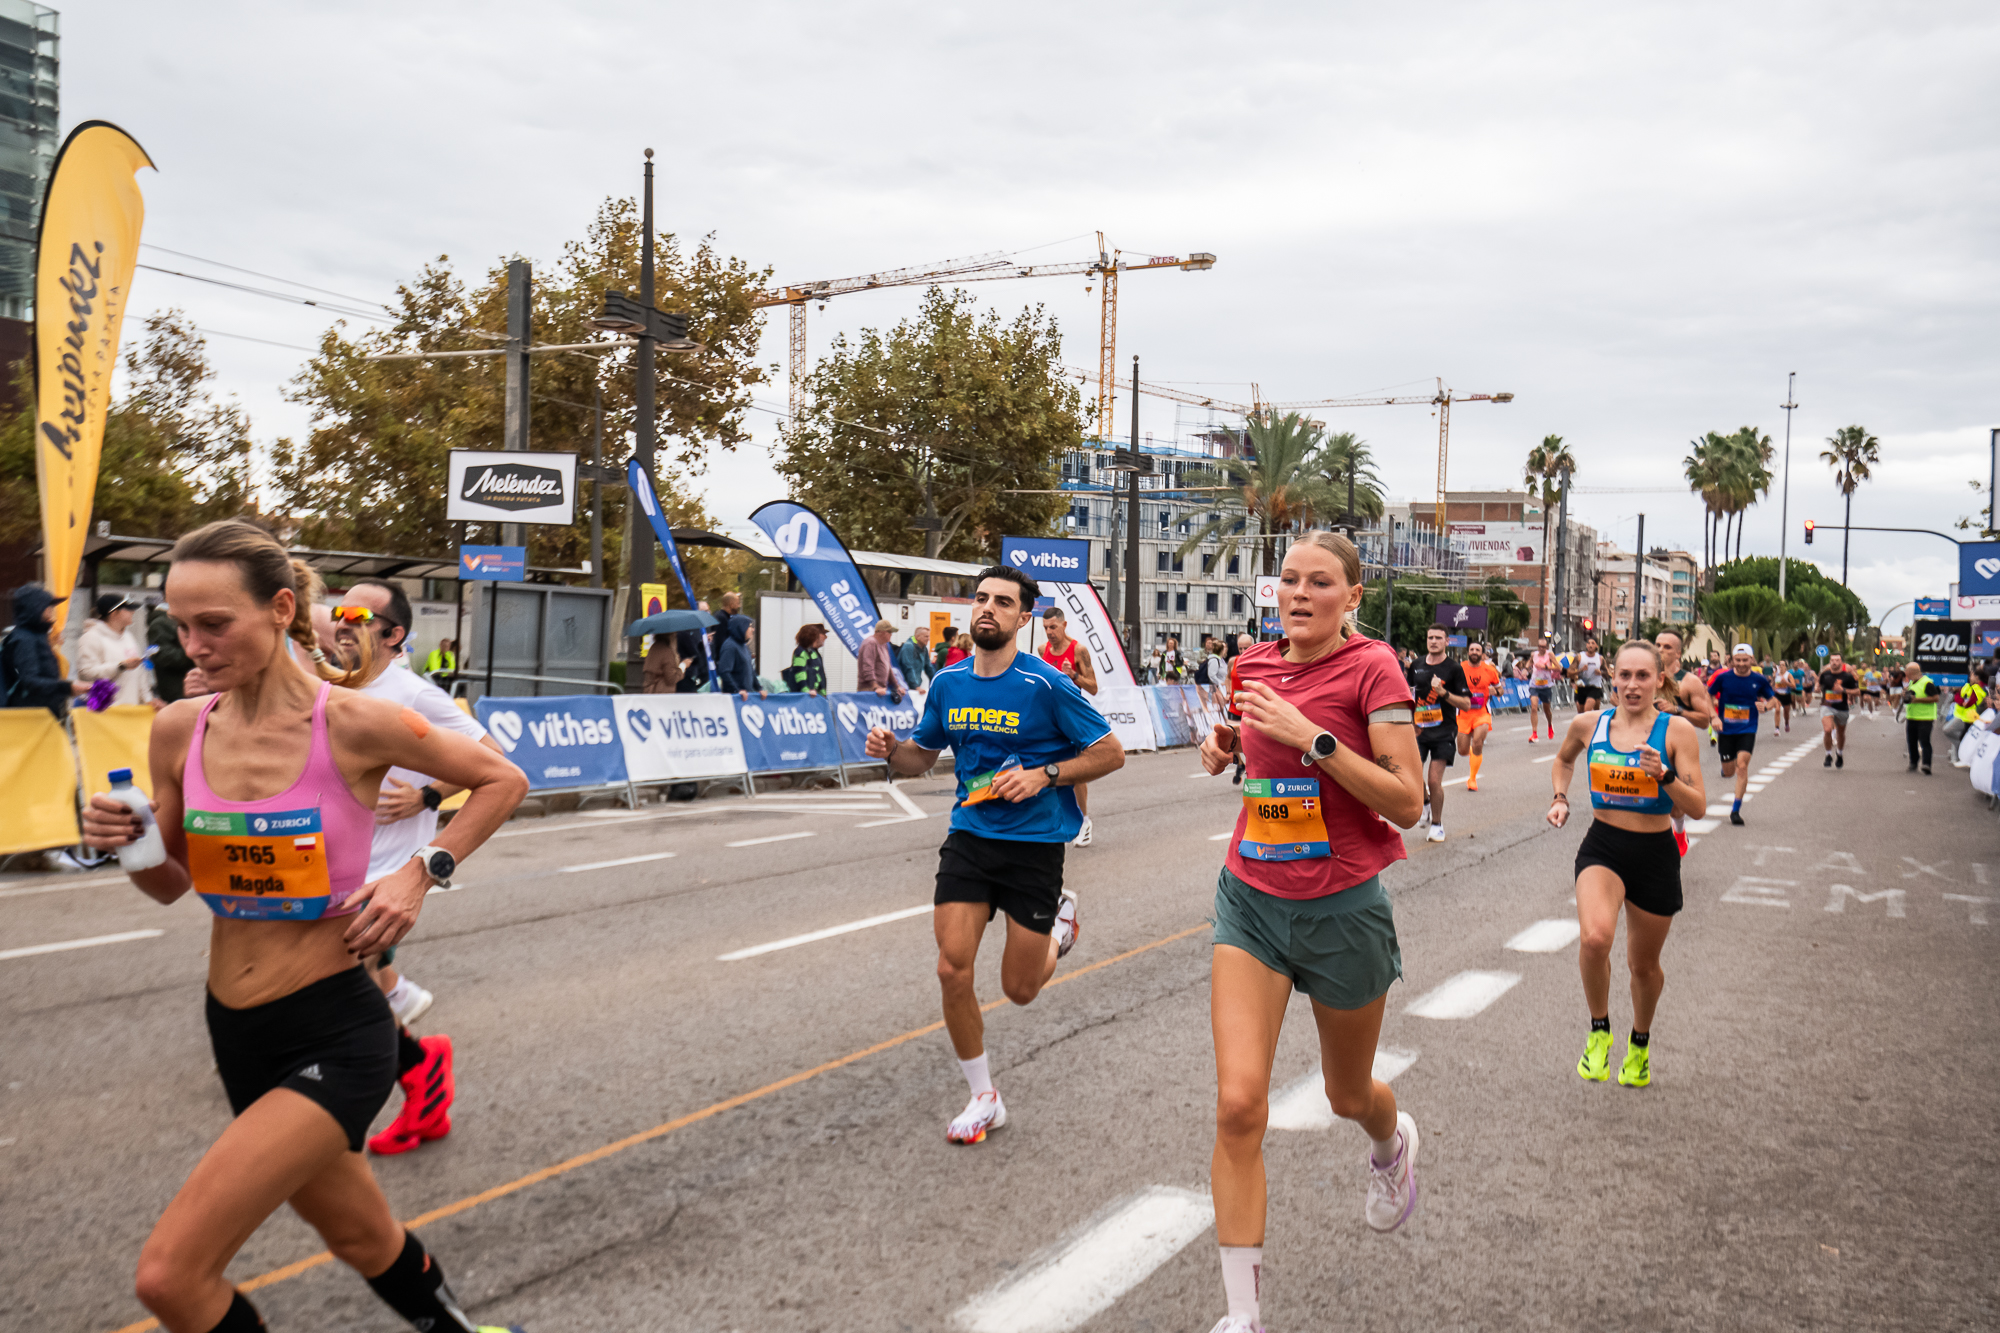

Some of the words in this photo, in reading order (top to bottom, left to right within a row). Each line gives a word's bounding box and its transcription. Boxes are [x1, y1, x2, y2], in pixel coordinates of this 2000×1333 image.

[1150, 256, 1174, 264] ATES
[464, 467, 562, 497] Meléndez.
[1031, 552, 1079, 569] vithas
[659, 710, 729, 740] vithas
[768, 706, 827, 736] vithas
[861, 705, 915, 731] vithas
[948, 707, 1020, 727] runners
[528, 711, 613, 748] vithas
[1609, 770, 1635, 781] 3735
[1287, 784, 1312, 792] ZURICH
[1605, 783, 1640, 795] Beatrice
[1258, 804, 1289, 819] 4689
[271, 816, 311, 829] ZURICH
[224, 844, 276, 865] 3765
[229, 874, 285, 895] Magda
[1719, 875, 1993, 925] EMT
